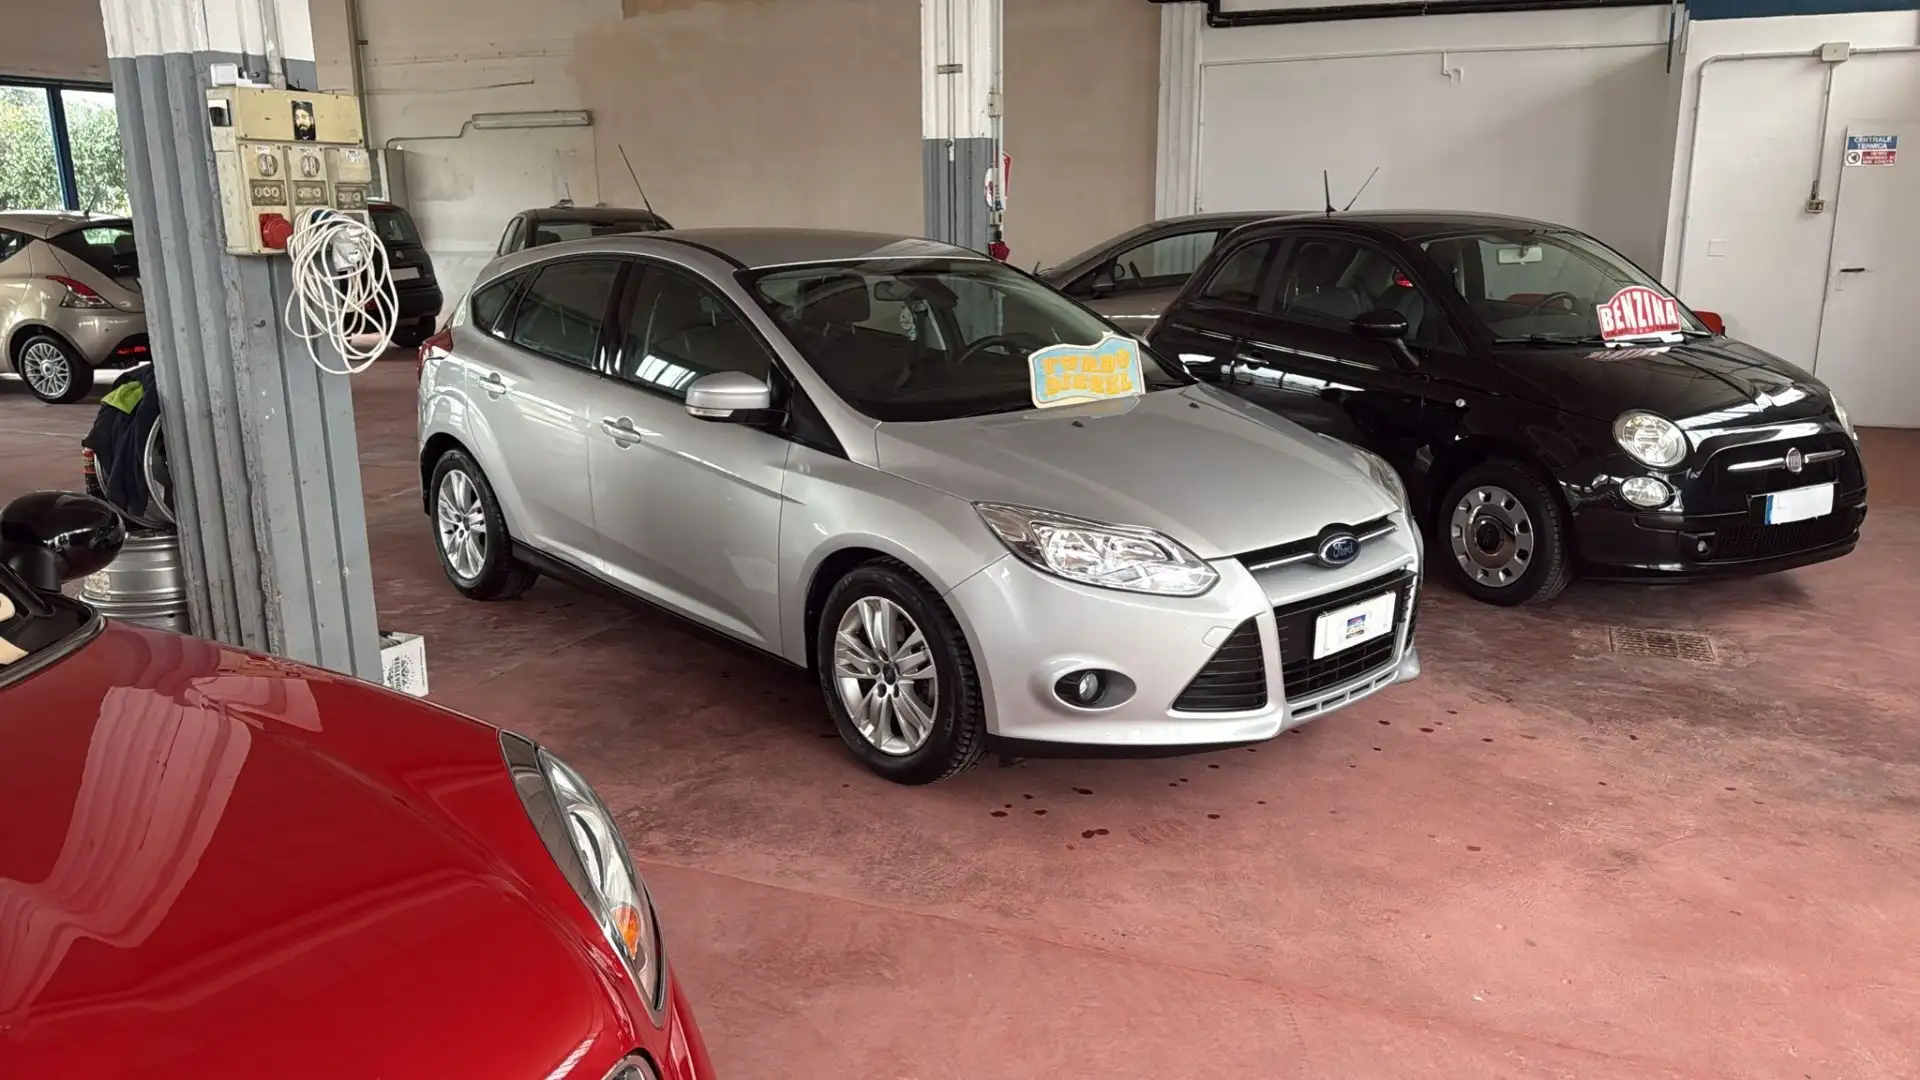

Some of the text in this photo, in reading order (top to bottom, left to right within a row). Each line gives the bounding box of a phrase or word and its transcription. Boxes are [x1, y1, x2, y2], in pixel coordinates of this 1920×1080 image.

[1853, 135, 1893, 143] CENTRALE
[1599, 291, 1678, 332] BENZINA
[1042, 347, 1131, 375] TURBO
[1044, 371, 1133, 396] DIESEL
[1332, 540, 1353, 558] Ford
